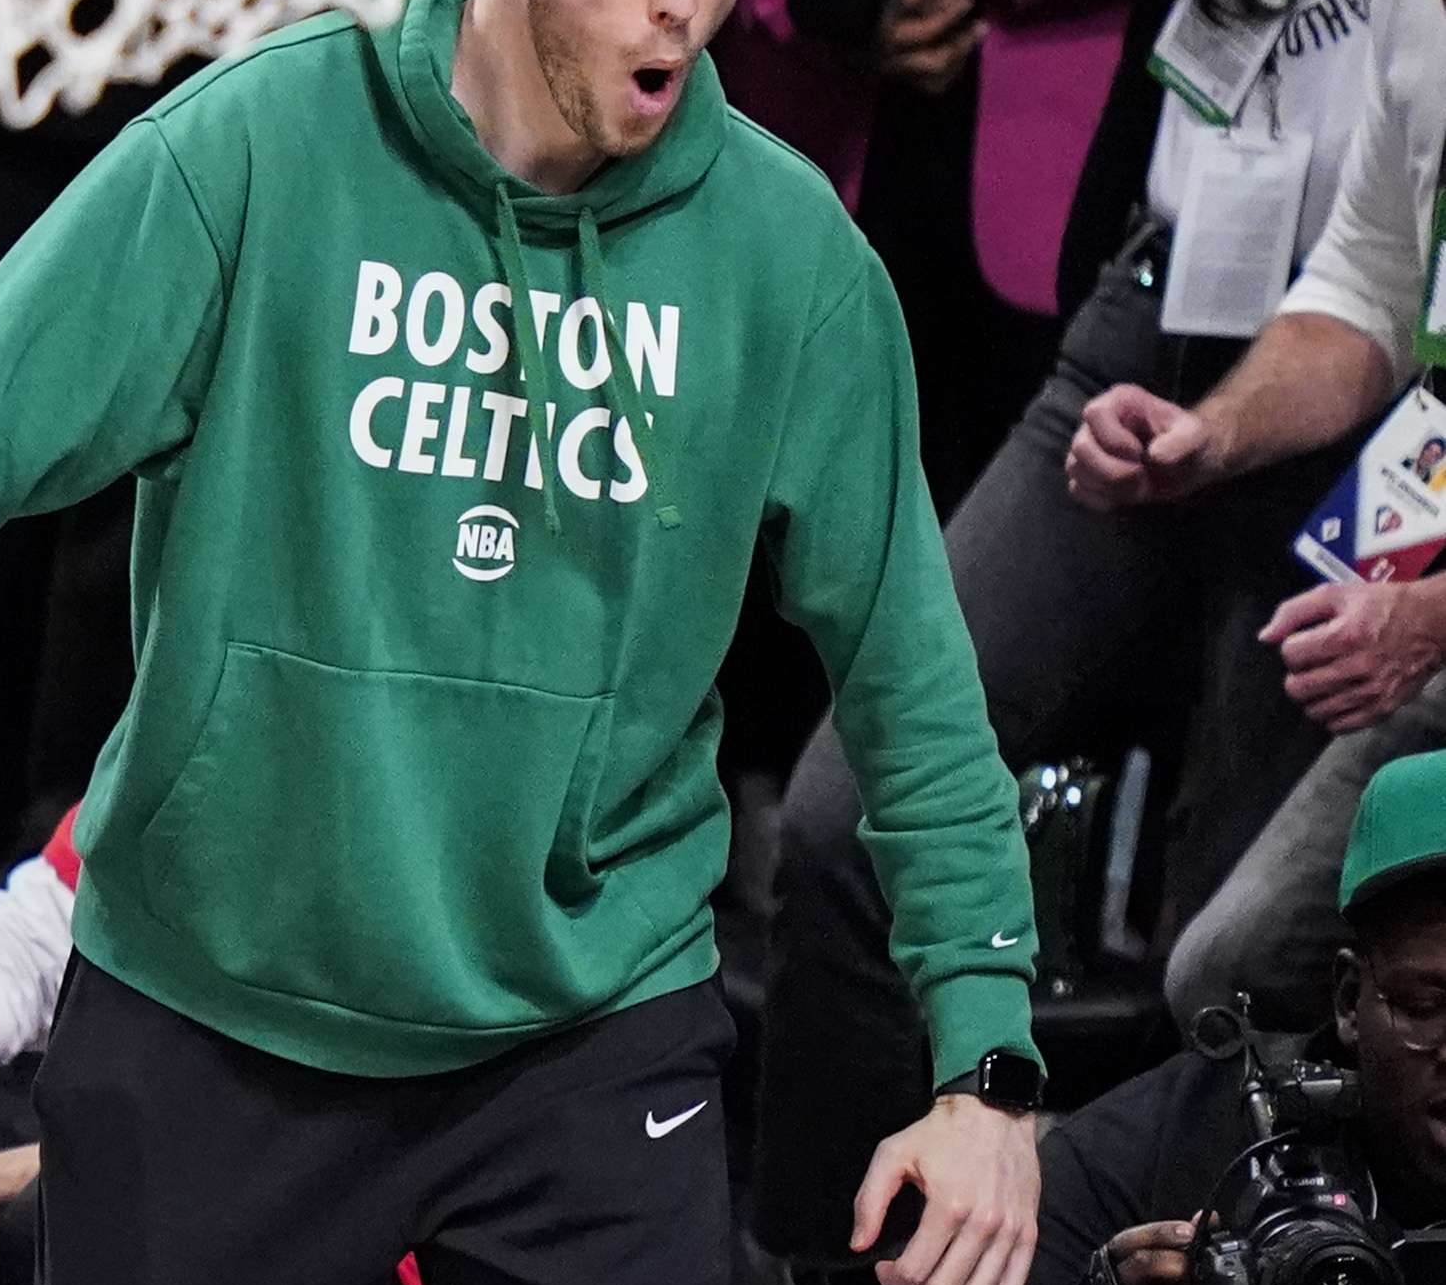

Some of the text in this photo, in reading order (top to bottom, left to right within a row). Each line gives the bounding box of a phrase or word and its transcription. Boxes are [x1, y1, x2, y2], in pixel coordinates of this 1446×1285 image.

[348, 260, 680, 397] BOSTON
[349, 376, 654, 503] CELTICS
[456, 522, 514, 561] NBA
